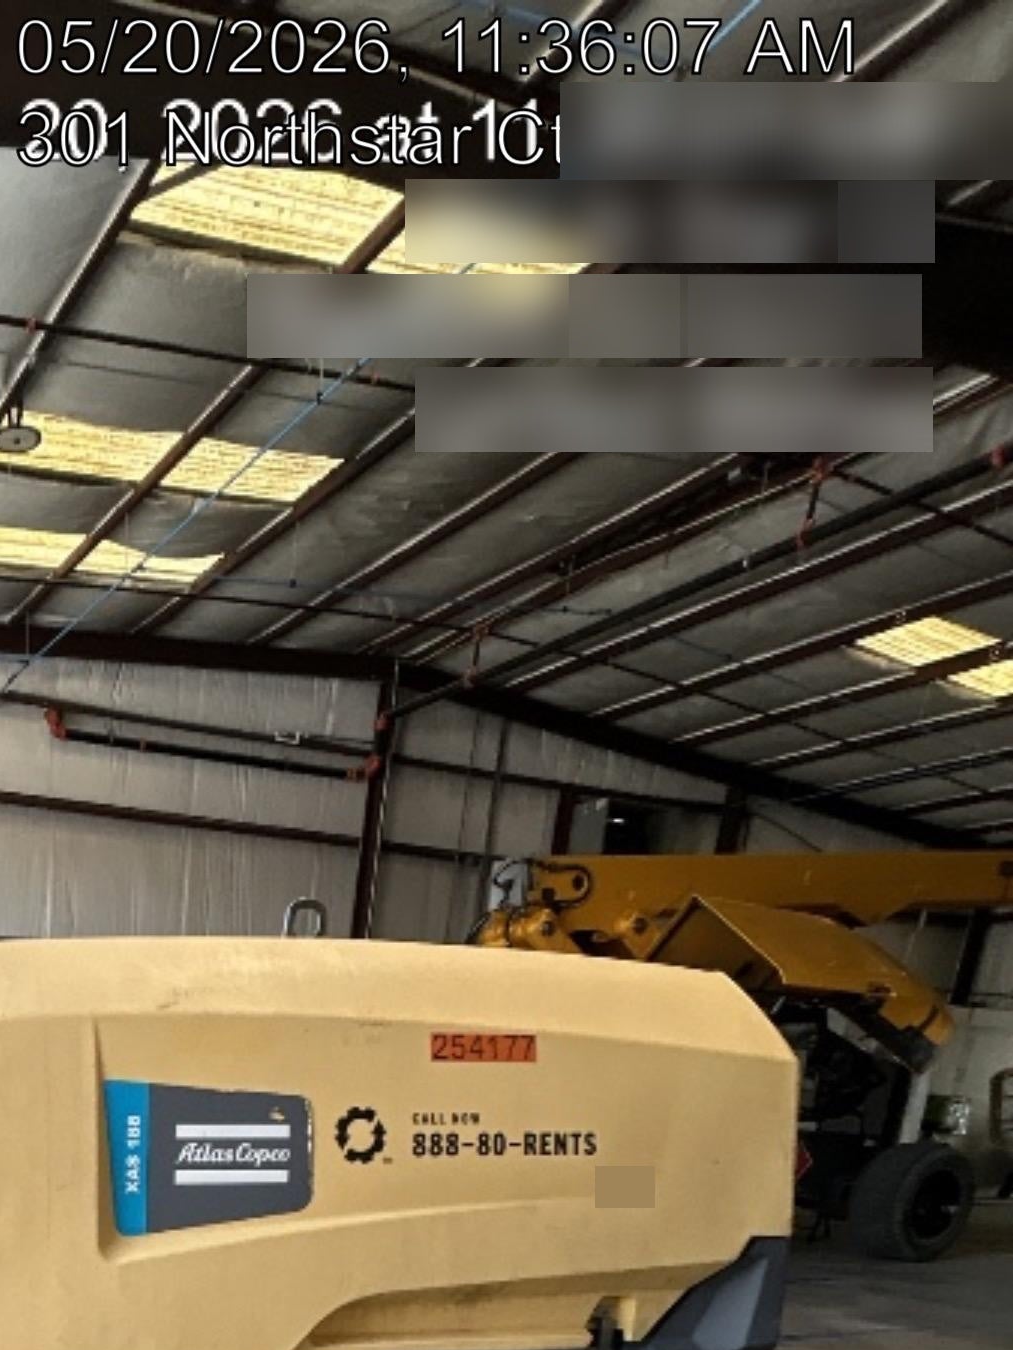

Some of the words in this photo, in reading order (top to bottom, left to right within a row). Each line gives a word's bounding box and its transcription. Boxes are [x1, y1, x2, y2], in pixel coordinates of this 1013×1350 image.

[433, 1034, 535, 1060] 254177
[126, 1115, 142, 1149] 188
[412, 1112, 446, 1126] CALL
[451, 1112, 481, 1126] NOW
[176, 1142, 234, 1165] Atlas
[235, 1142, 292, 1168] Copco
[412, 1132, 598, 1157] 888-80-RENTS
[125, 1155, 141, 1195] XAS
